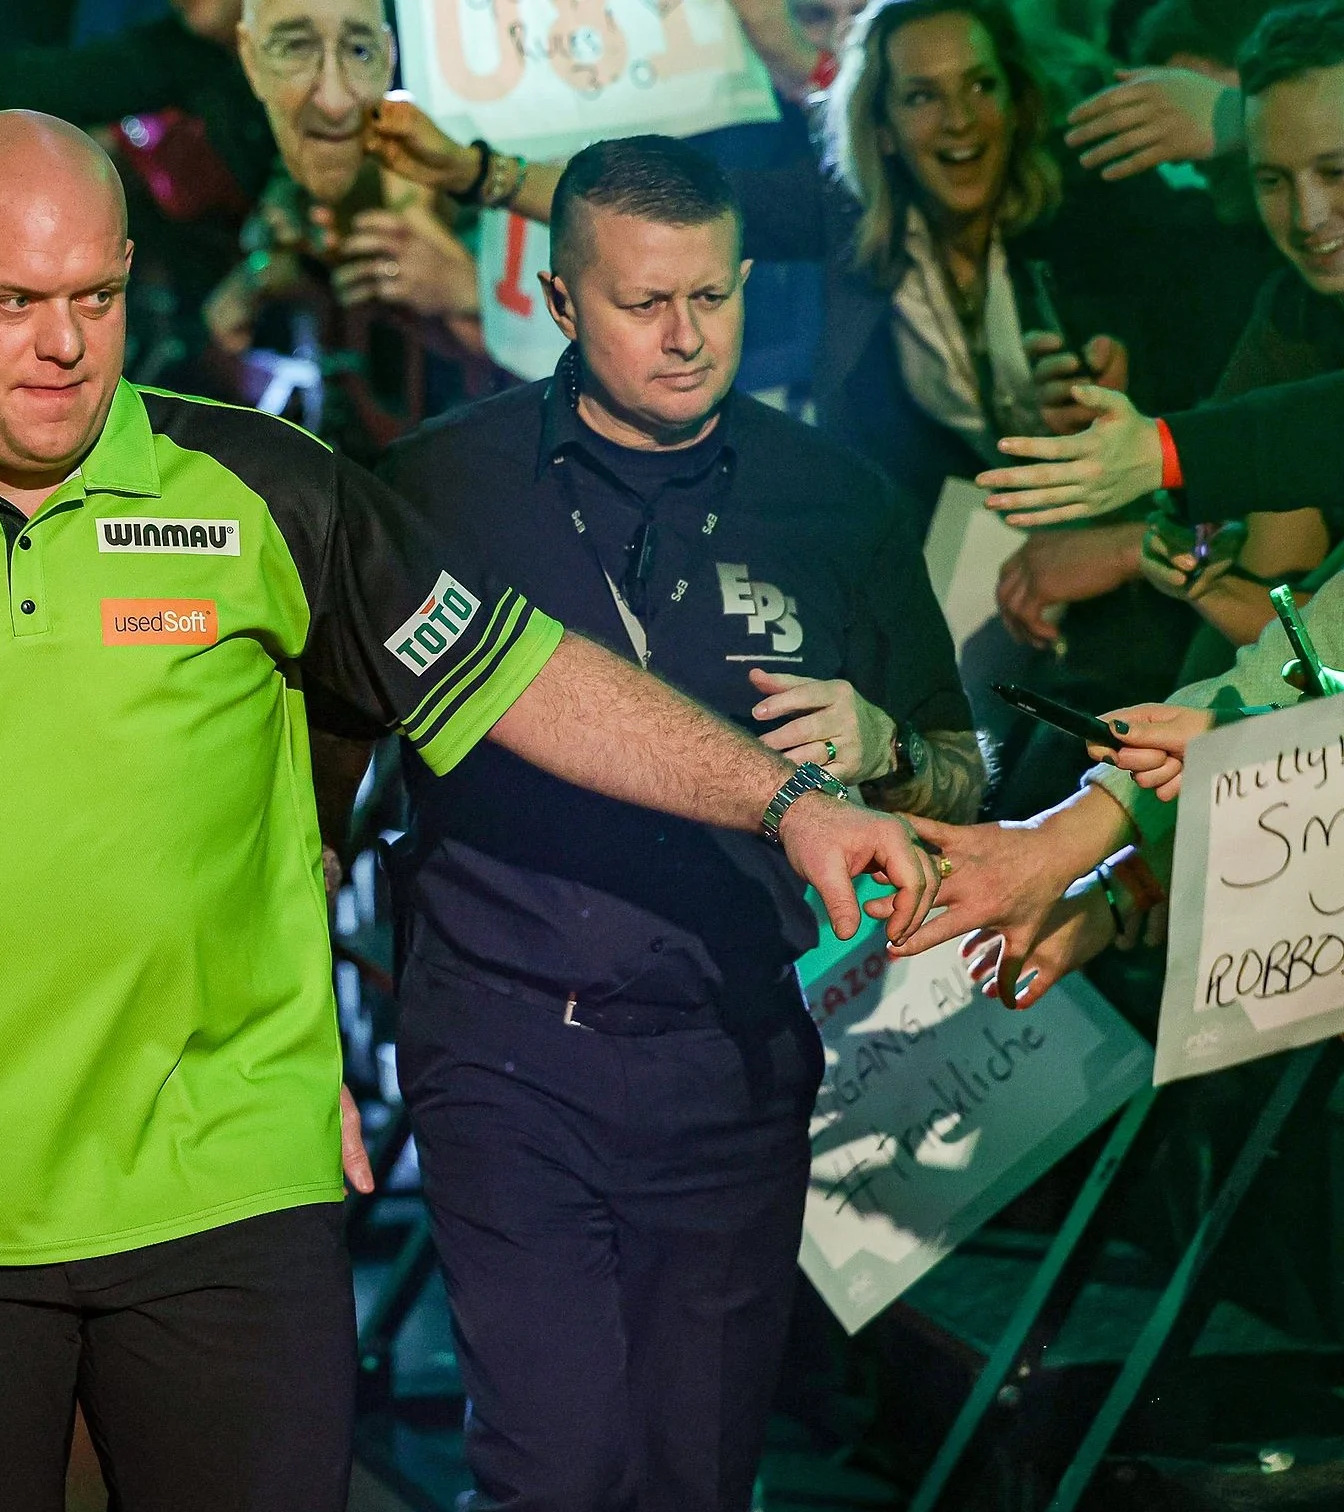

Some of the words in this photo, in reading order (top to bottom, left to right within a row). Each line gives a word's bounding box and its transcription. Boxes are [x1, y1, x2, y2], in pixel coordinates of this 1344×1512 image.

[103, 523, 227, 548] WINMAU
[702, 512, 718, 535] EPS
[671, 579, 689, 602] EPS
[716, 562, 803, 653] EPS
[114, 610, 207, 633] usedSoft
[395, 587, 473, 668] TOTO
